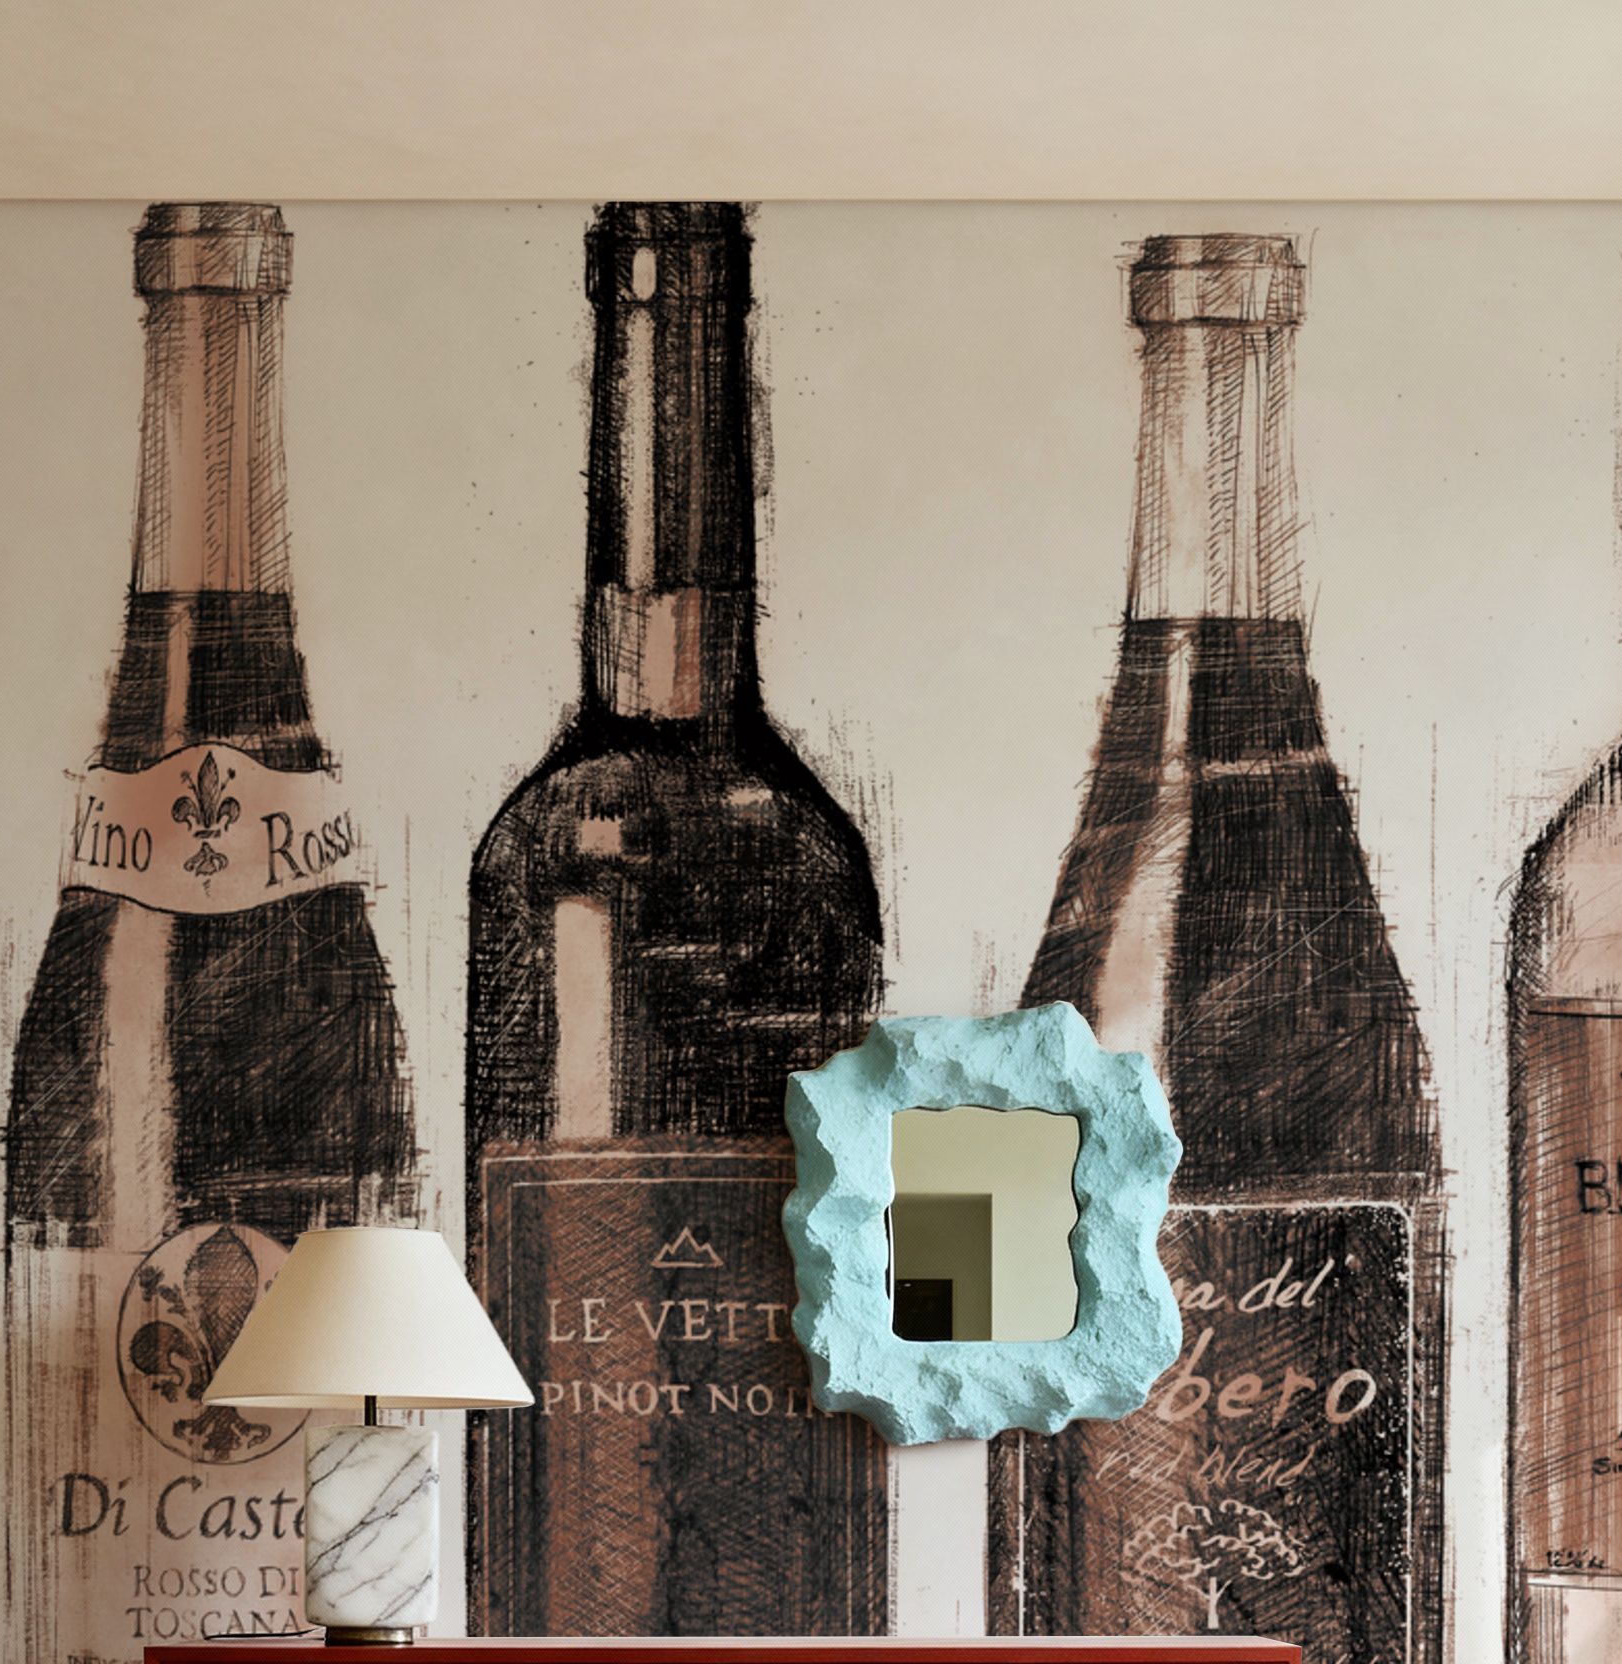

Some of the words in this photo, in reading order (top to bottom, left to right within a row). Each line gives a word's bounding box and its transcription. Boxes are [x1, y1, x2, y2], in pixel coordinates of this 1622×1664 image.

[70, 796, 153, 873] Vino
[1238, 1256, 1336, 1314] del
[550, 1299, 613, 1344] LE
[635, 1299, 788, 1343] VETT
[538, 1379, 691, 1417] PINOT
[51, 1472, 131, 1538] Di
[133, 1565, 246, 1598] ROSSO
[257, 1566, 301, 1598] DI
[125, 1606, 304, 1641] TOSCANA
